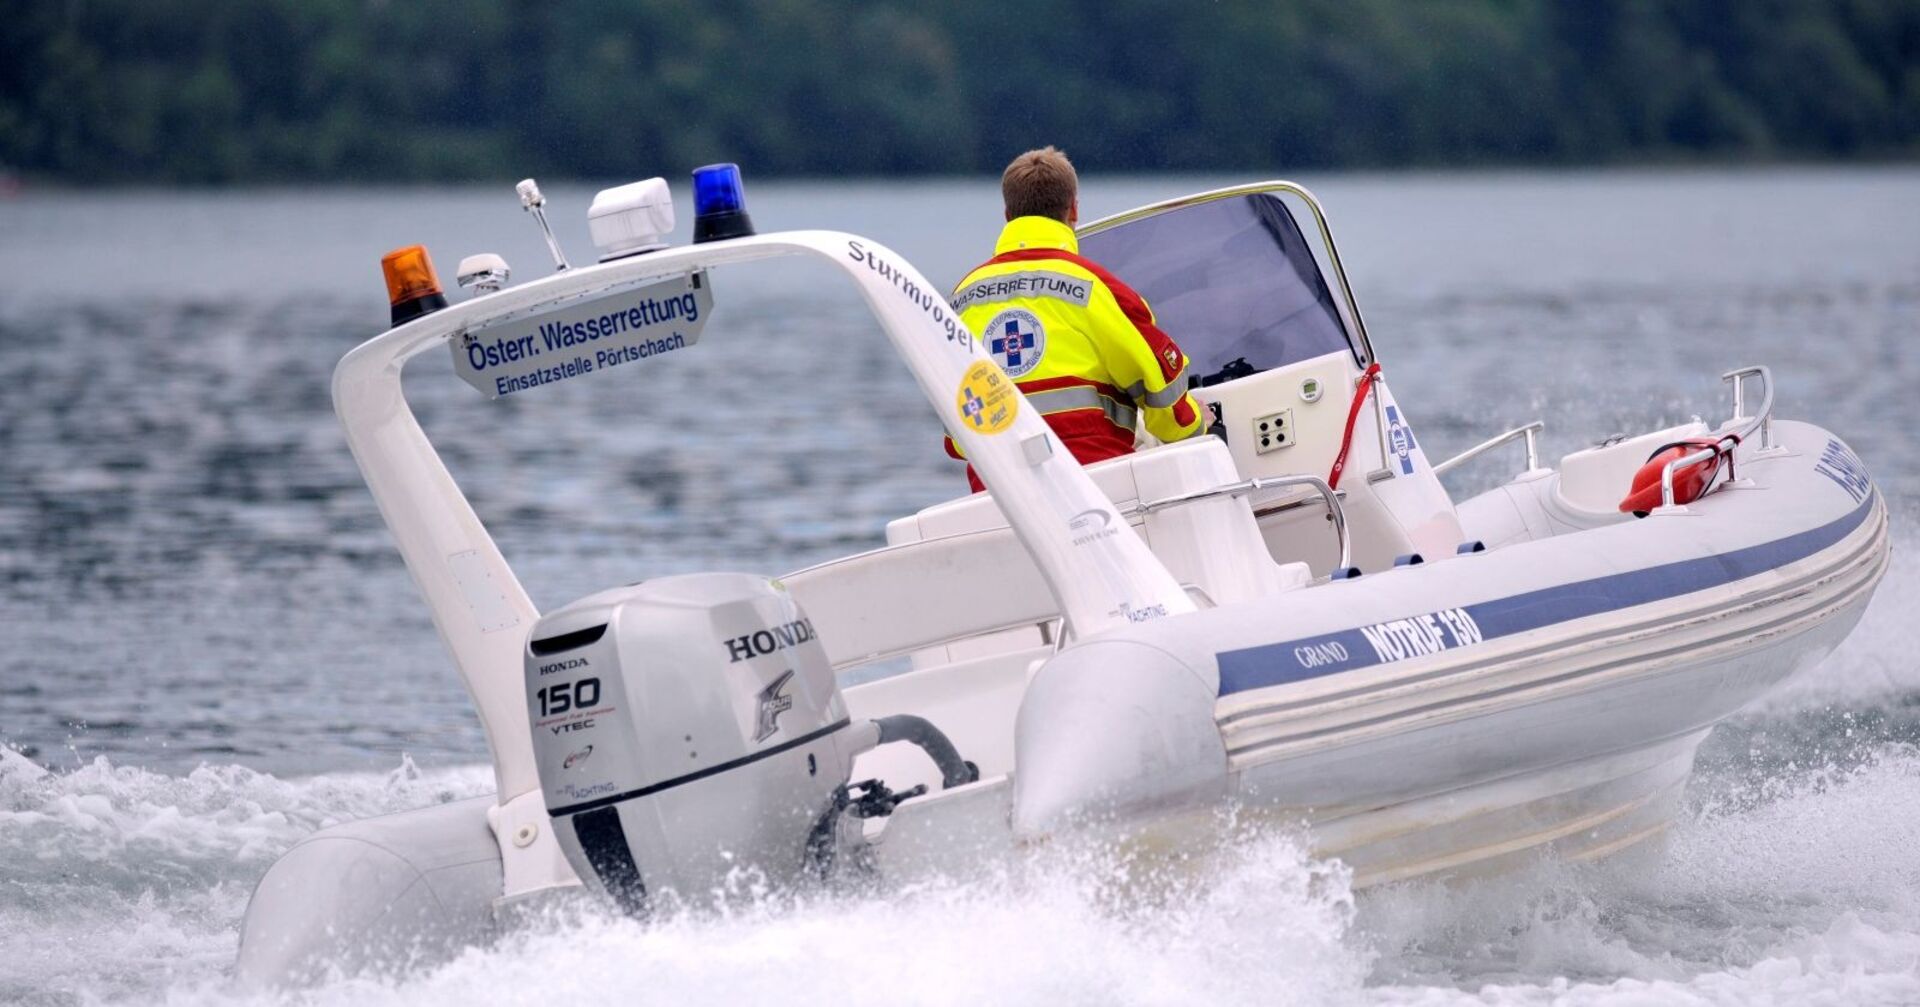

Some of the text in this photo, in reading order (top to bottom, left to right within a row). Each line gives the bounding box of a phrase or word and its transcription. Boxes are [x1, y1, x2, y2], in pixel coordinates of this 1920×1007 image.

[847, 240, 974, 354] Sturmvogel
[949, 277, 1086, 311] WASSERRETTUNG
[467, 291, 699, 371] Österr. Wasserrettung
[496, 331, 685, 396] Einsatzstelle Pörtschach
[723, 617, 819, 663] HONDA
[1294, 606, 1483, 669] GRAND NOTRUF 130
[539, 657, 590, 676] HONDA
[537, 677, 601, 718] 150
[551, 719, 596, 737] VTEC
